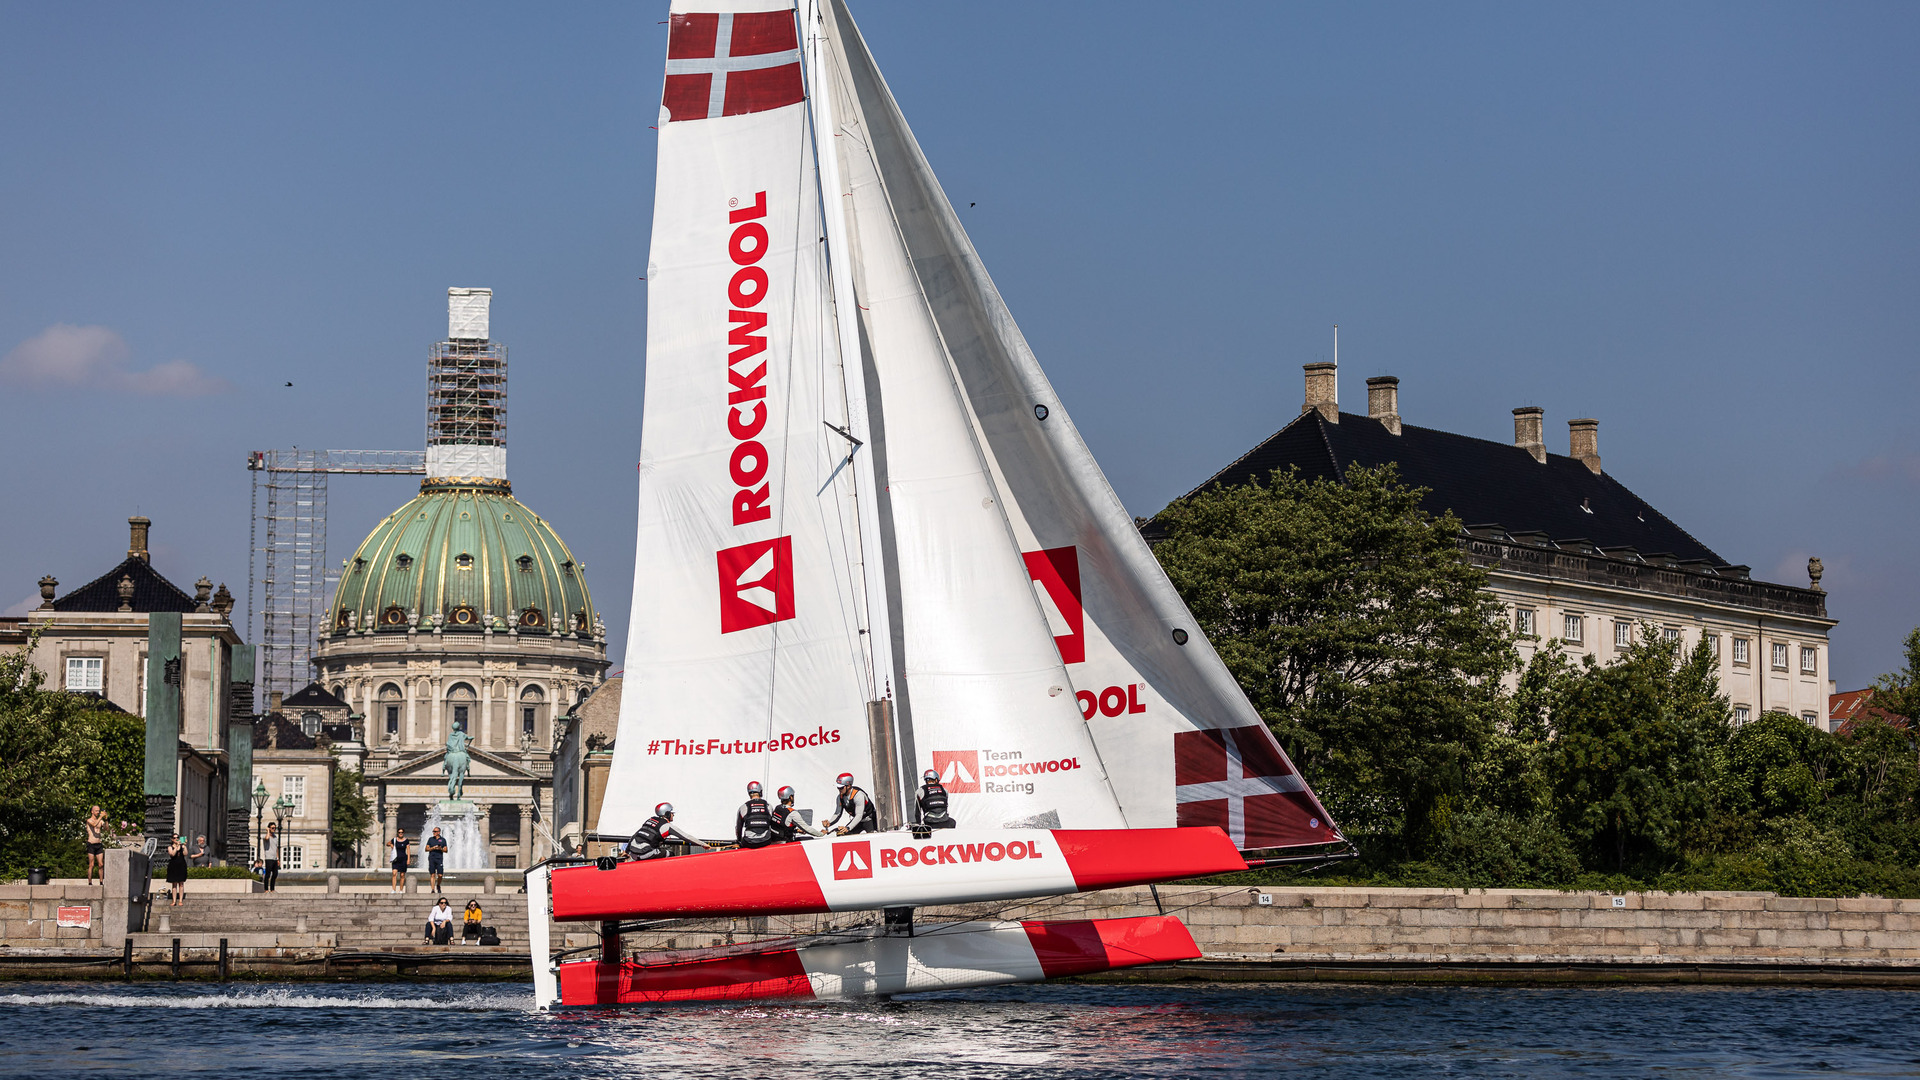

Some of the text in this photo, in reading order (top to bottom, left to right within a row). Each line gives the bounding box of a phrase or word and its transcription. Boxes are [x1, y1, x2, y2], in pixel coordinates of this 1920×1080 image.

[647, 726, 841, 756] #ThisFutureRocks
[982, 749, 1023, 761] Team
[985, 781, 1035, 795] Racing
[1614, 898, 1624, 906] 15
